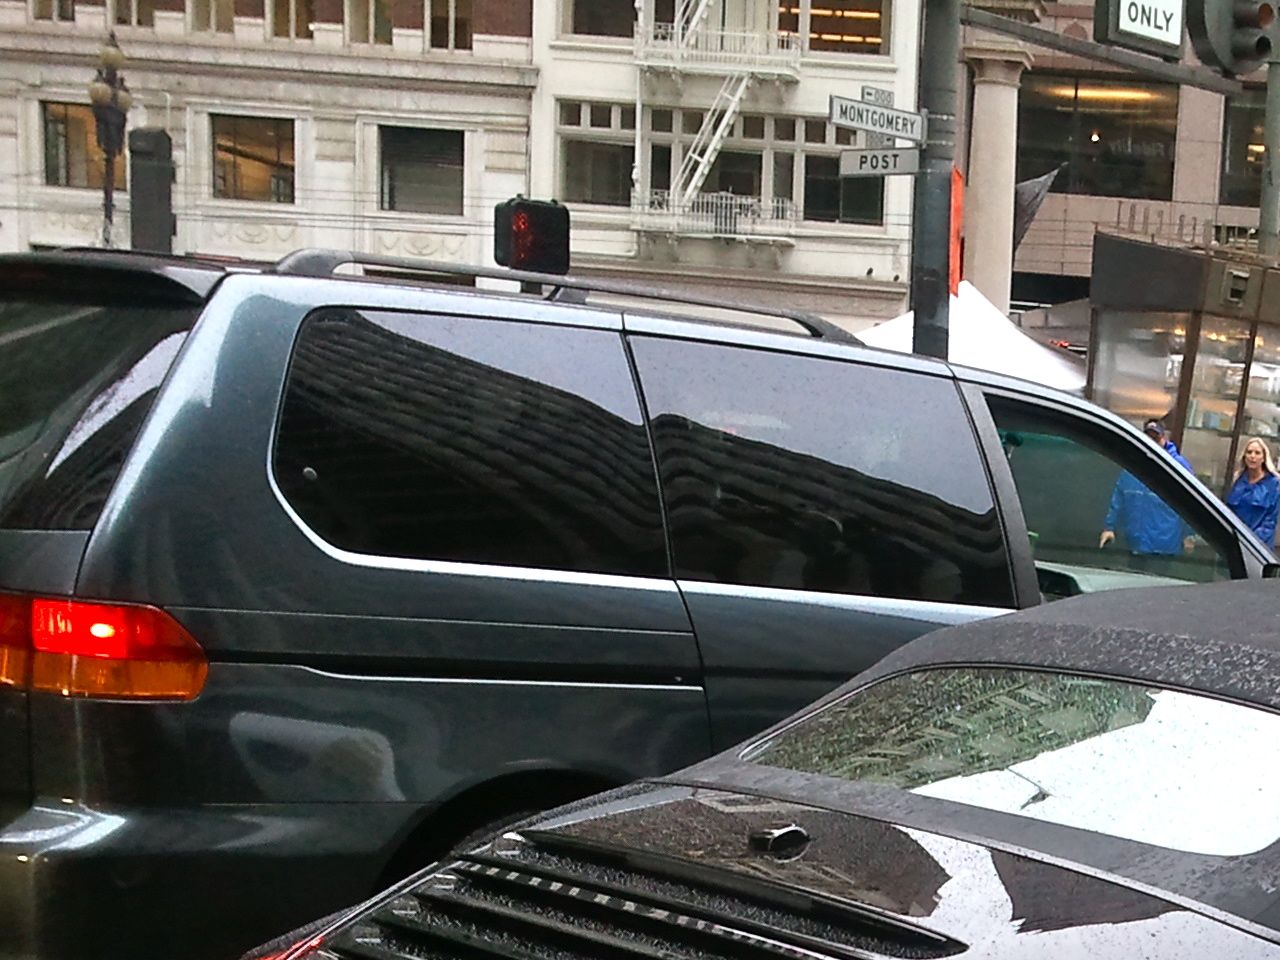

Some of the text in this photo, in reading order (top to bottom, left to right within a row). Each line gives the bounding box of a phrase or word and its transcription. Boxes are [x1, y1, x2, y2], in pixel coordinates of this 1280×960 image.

[1128, 1, 1174, 32] ONLY
[840, 103, 916, 135] MONTGOMERY
[859, 153, 899, 170] POST
